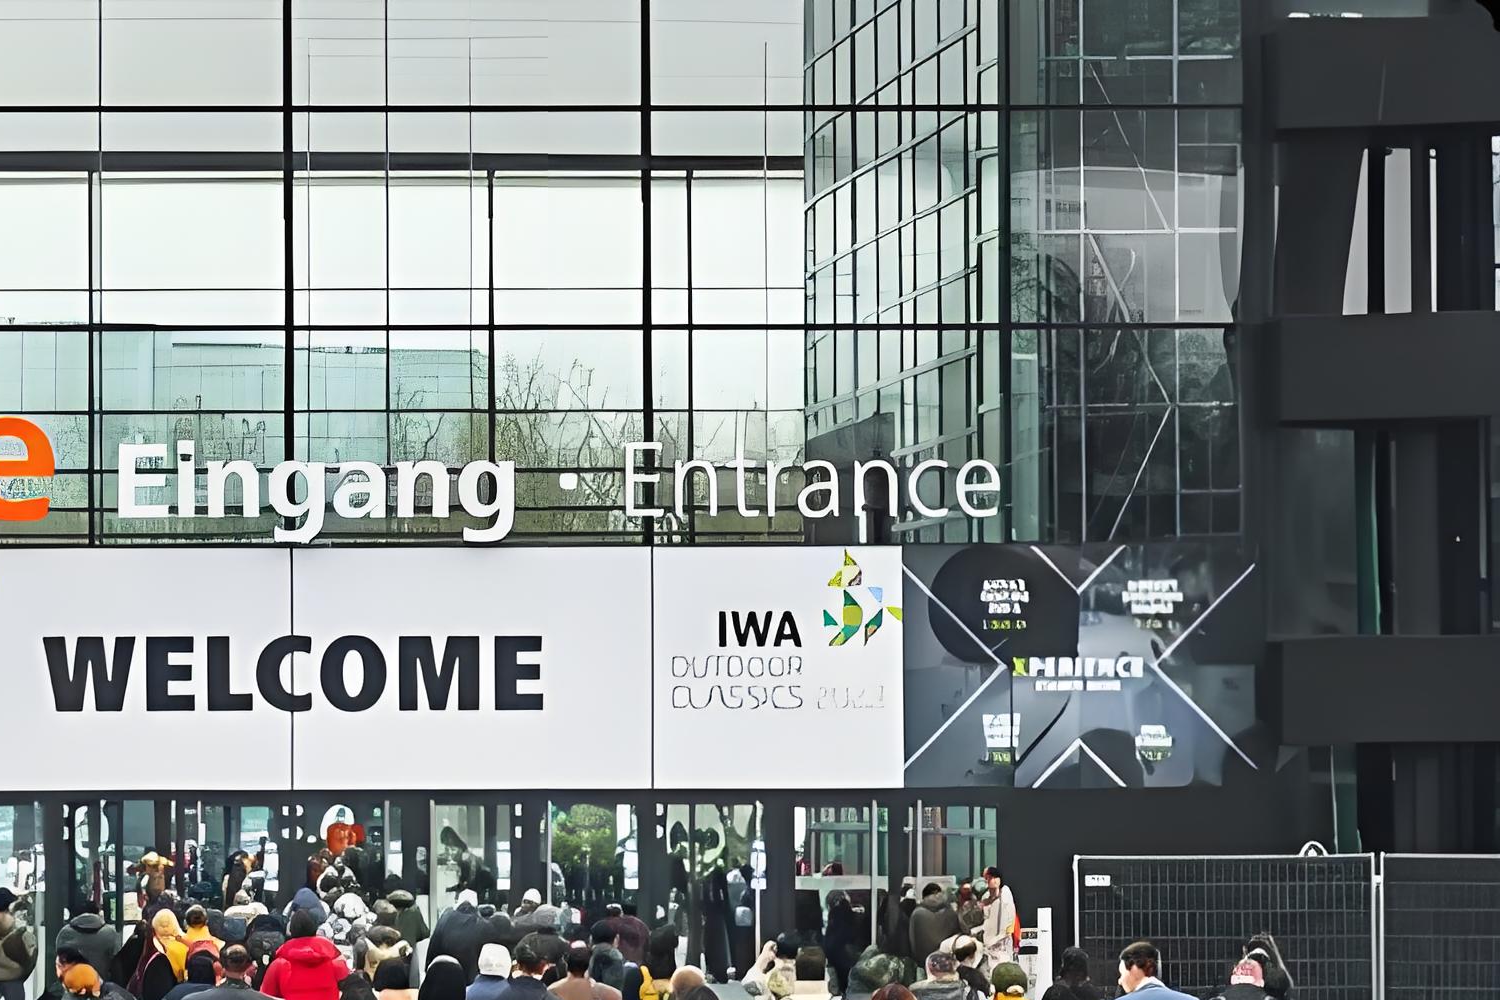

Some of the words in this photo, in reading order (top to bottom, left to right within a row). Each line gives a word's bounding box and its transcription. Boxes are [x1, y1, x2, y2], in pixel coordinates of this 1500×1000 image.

[118, 440, 516, 544] Eingang
[623, 440, 1003, 520] Entrance
[718, 610, 802, 647] IWA
[42, 634, 544, 714] WELCOME
[671, 655, 802, 679] OUTDOOR
